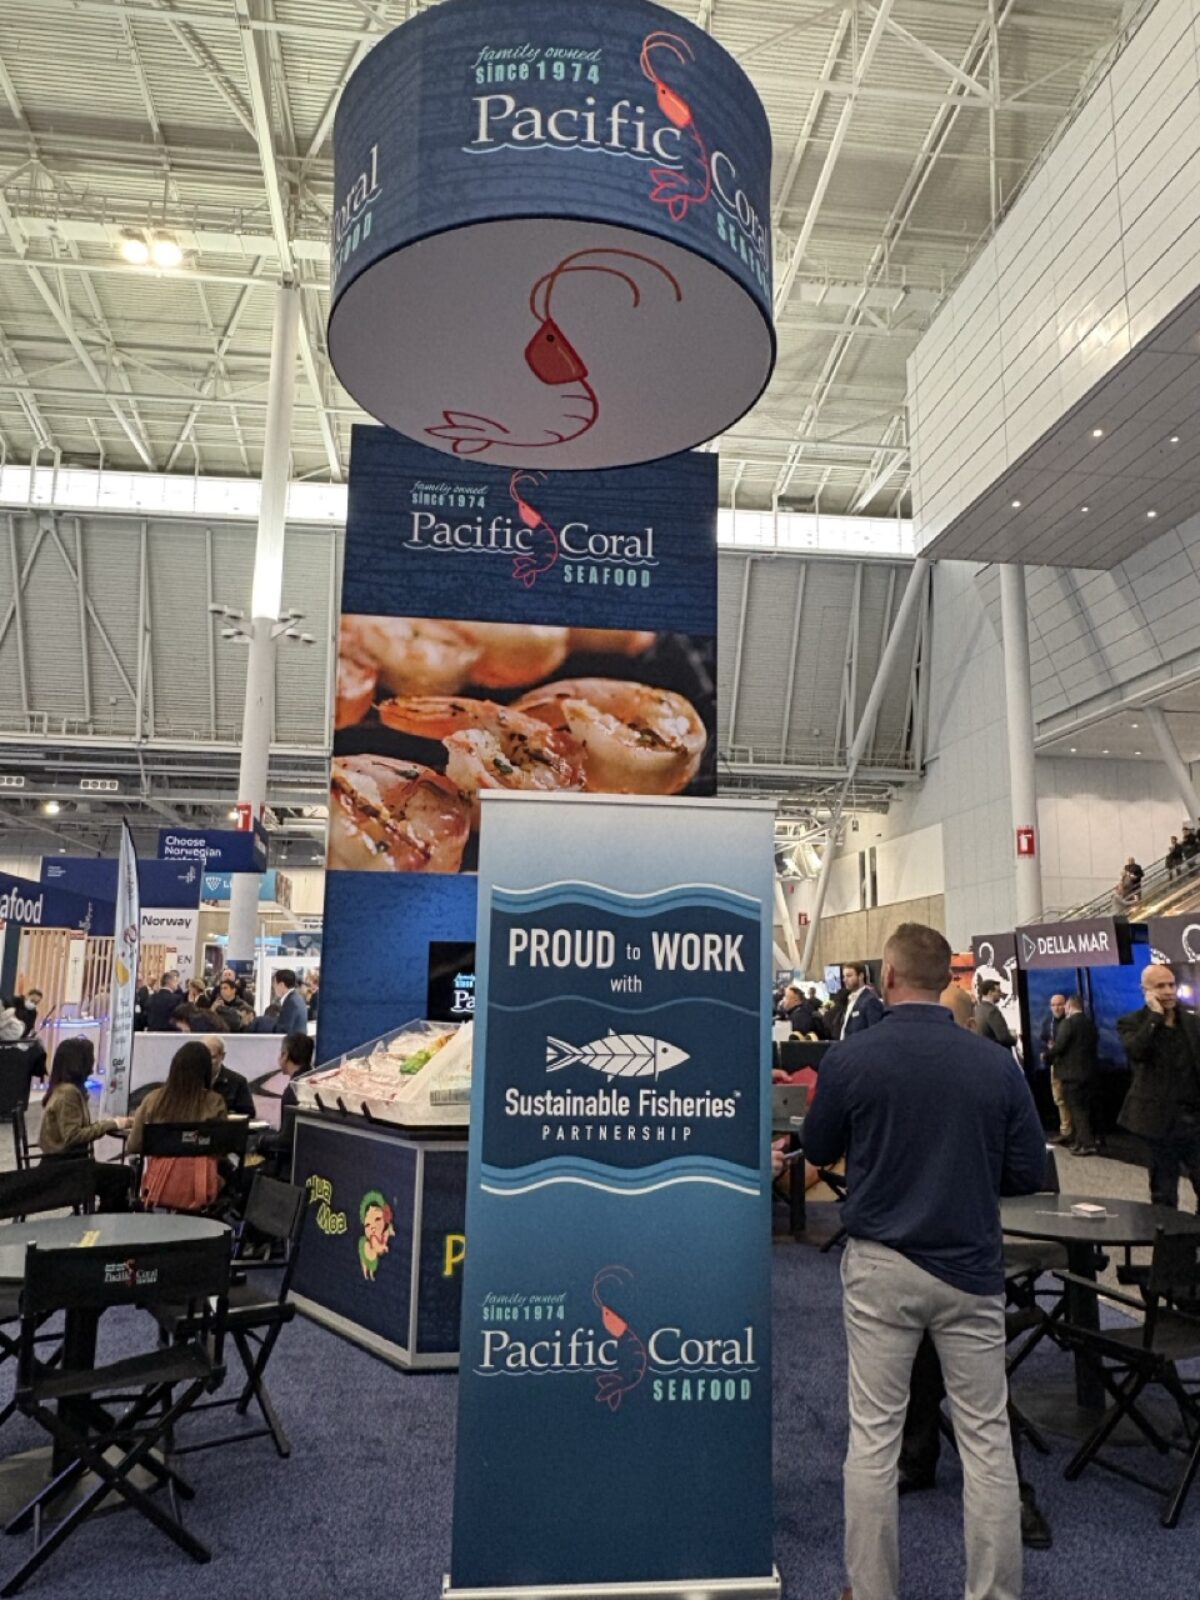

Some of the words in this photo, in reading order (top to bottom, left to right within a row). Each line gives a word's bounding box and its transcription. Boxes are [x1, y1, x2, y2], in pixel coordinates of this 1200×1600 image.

[470, 43, 541, 69] family
[544, 47, 602, 61] owned
[475, 61, 530, 84] since
[536, 60, 600, 84] 1974
[470, 93, 682, 160] Pacific
[412, 490, 444, 506] since
[448, 494, 485, 509] 1974
[409, 510, 533, 550] Pacific
[559, 521, 656, 559] Coral
[564, 564, 651, 588] SEAFOOD
[164, 835, 206, 847] Choose
[164, 846, 222, 858] Norwegian
[142, 915, 192, 929] Norway
[508, 928, 616, 969] PROUD
[626, 943, 642, 960] to
[651, 931, 746, 972] WORK
[1037, 934, 1077, 955] DELLA
[1078, 930, 1110, 952] MAR
[610, 974, 643, 993] with
[505, 1087, 630, 1117] Sustainable
[541, 1124, 692, 1141] PARTNERSHIP
[479, 1291, 527, 1307] family
[482, 1304, 519, 1321] since
[523, 1304, 565, 1320] 1974
[479, 1327, 618, 1369] Pacific
[649, 1326, 756, 1366] Coral
[653, 1378, 752, 1401] SEAFOOD
